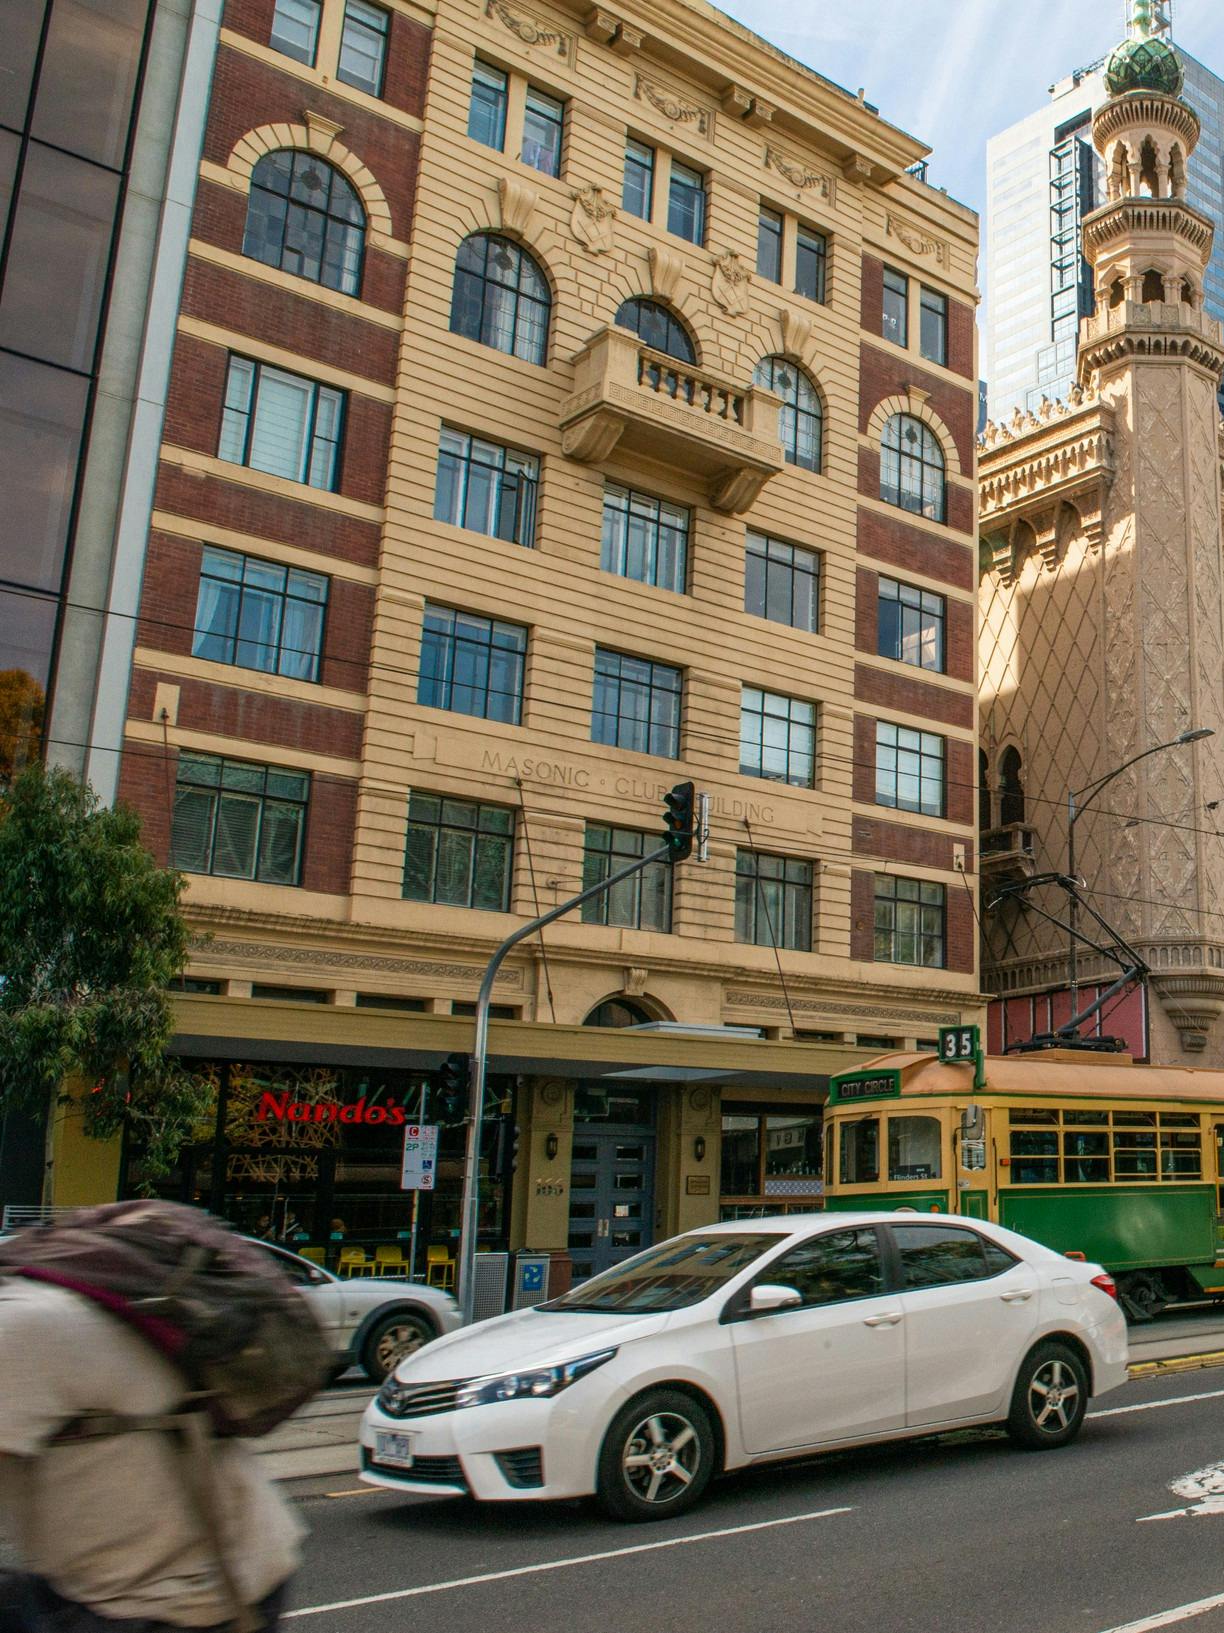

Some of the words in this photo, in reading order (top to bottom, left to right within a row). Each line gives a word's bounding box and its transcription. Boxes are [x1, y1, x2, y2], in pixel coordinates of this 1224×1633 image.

[481, 750, 590, 787] MASONIC
[945, 1032, 972, 1057] 35
[841, 1082, 861, 1098] CITY
[864, 1078, 895, 1095] CIRCLE
[256, 1091, 406, 1125] Nando's
[406, 1142, 420, 1152] 2P
